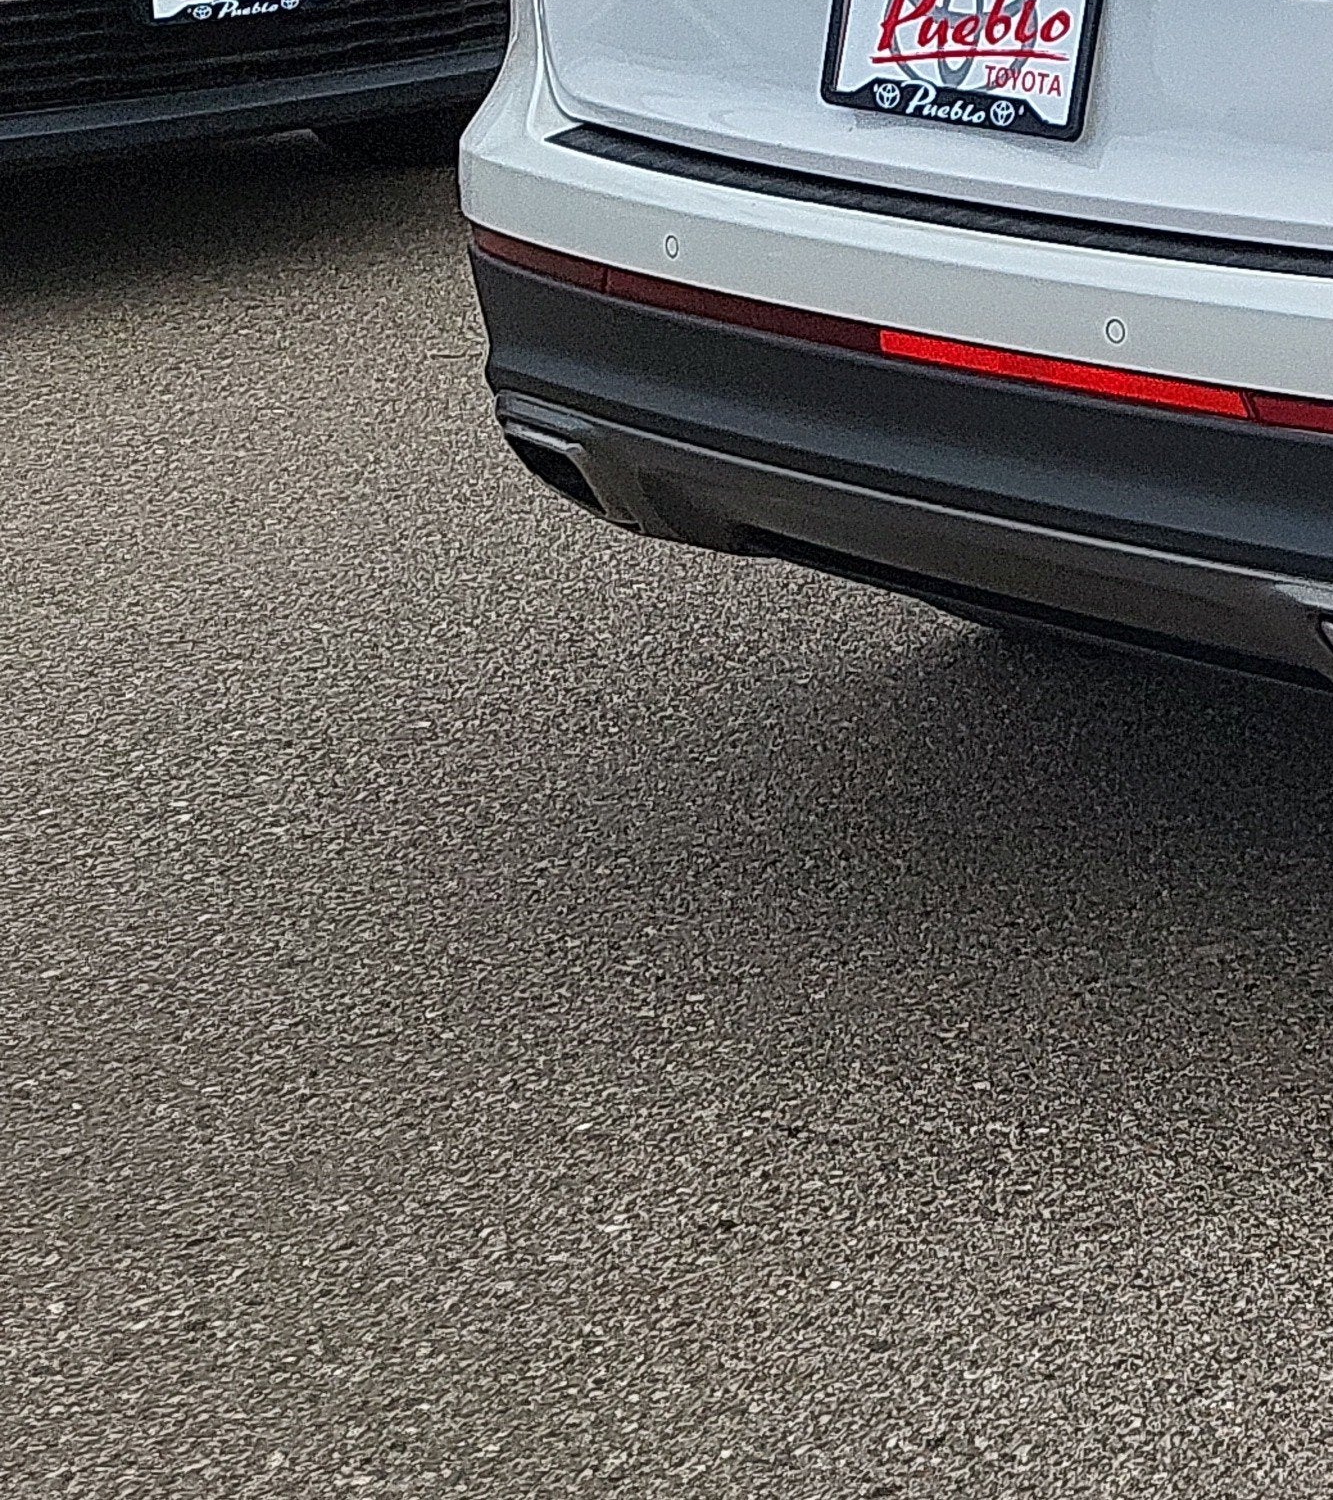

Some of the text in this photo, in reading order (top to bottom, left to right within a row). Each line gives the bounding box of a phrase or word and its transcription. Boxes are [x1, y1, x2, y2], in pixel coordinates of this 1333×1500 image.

[211, 0, 279, 20] Pueblo
[984, 64, 1062, 97] TOYOTA
[900, 79, 987, 124] Pueblo
